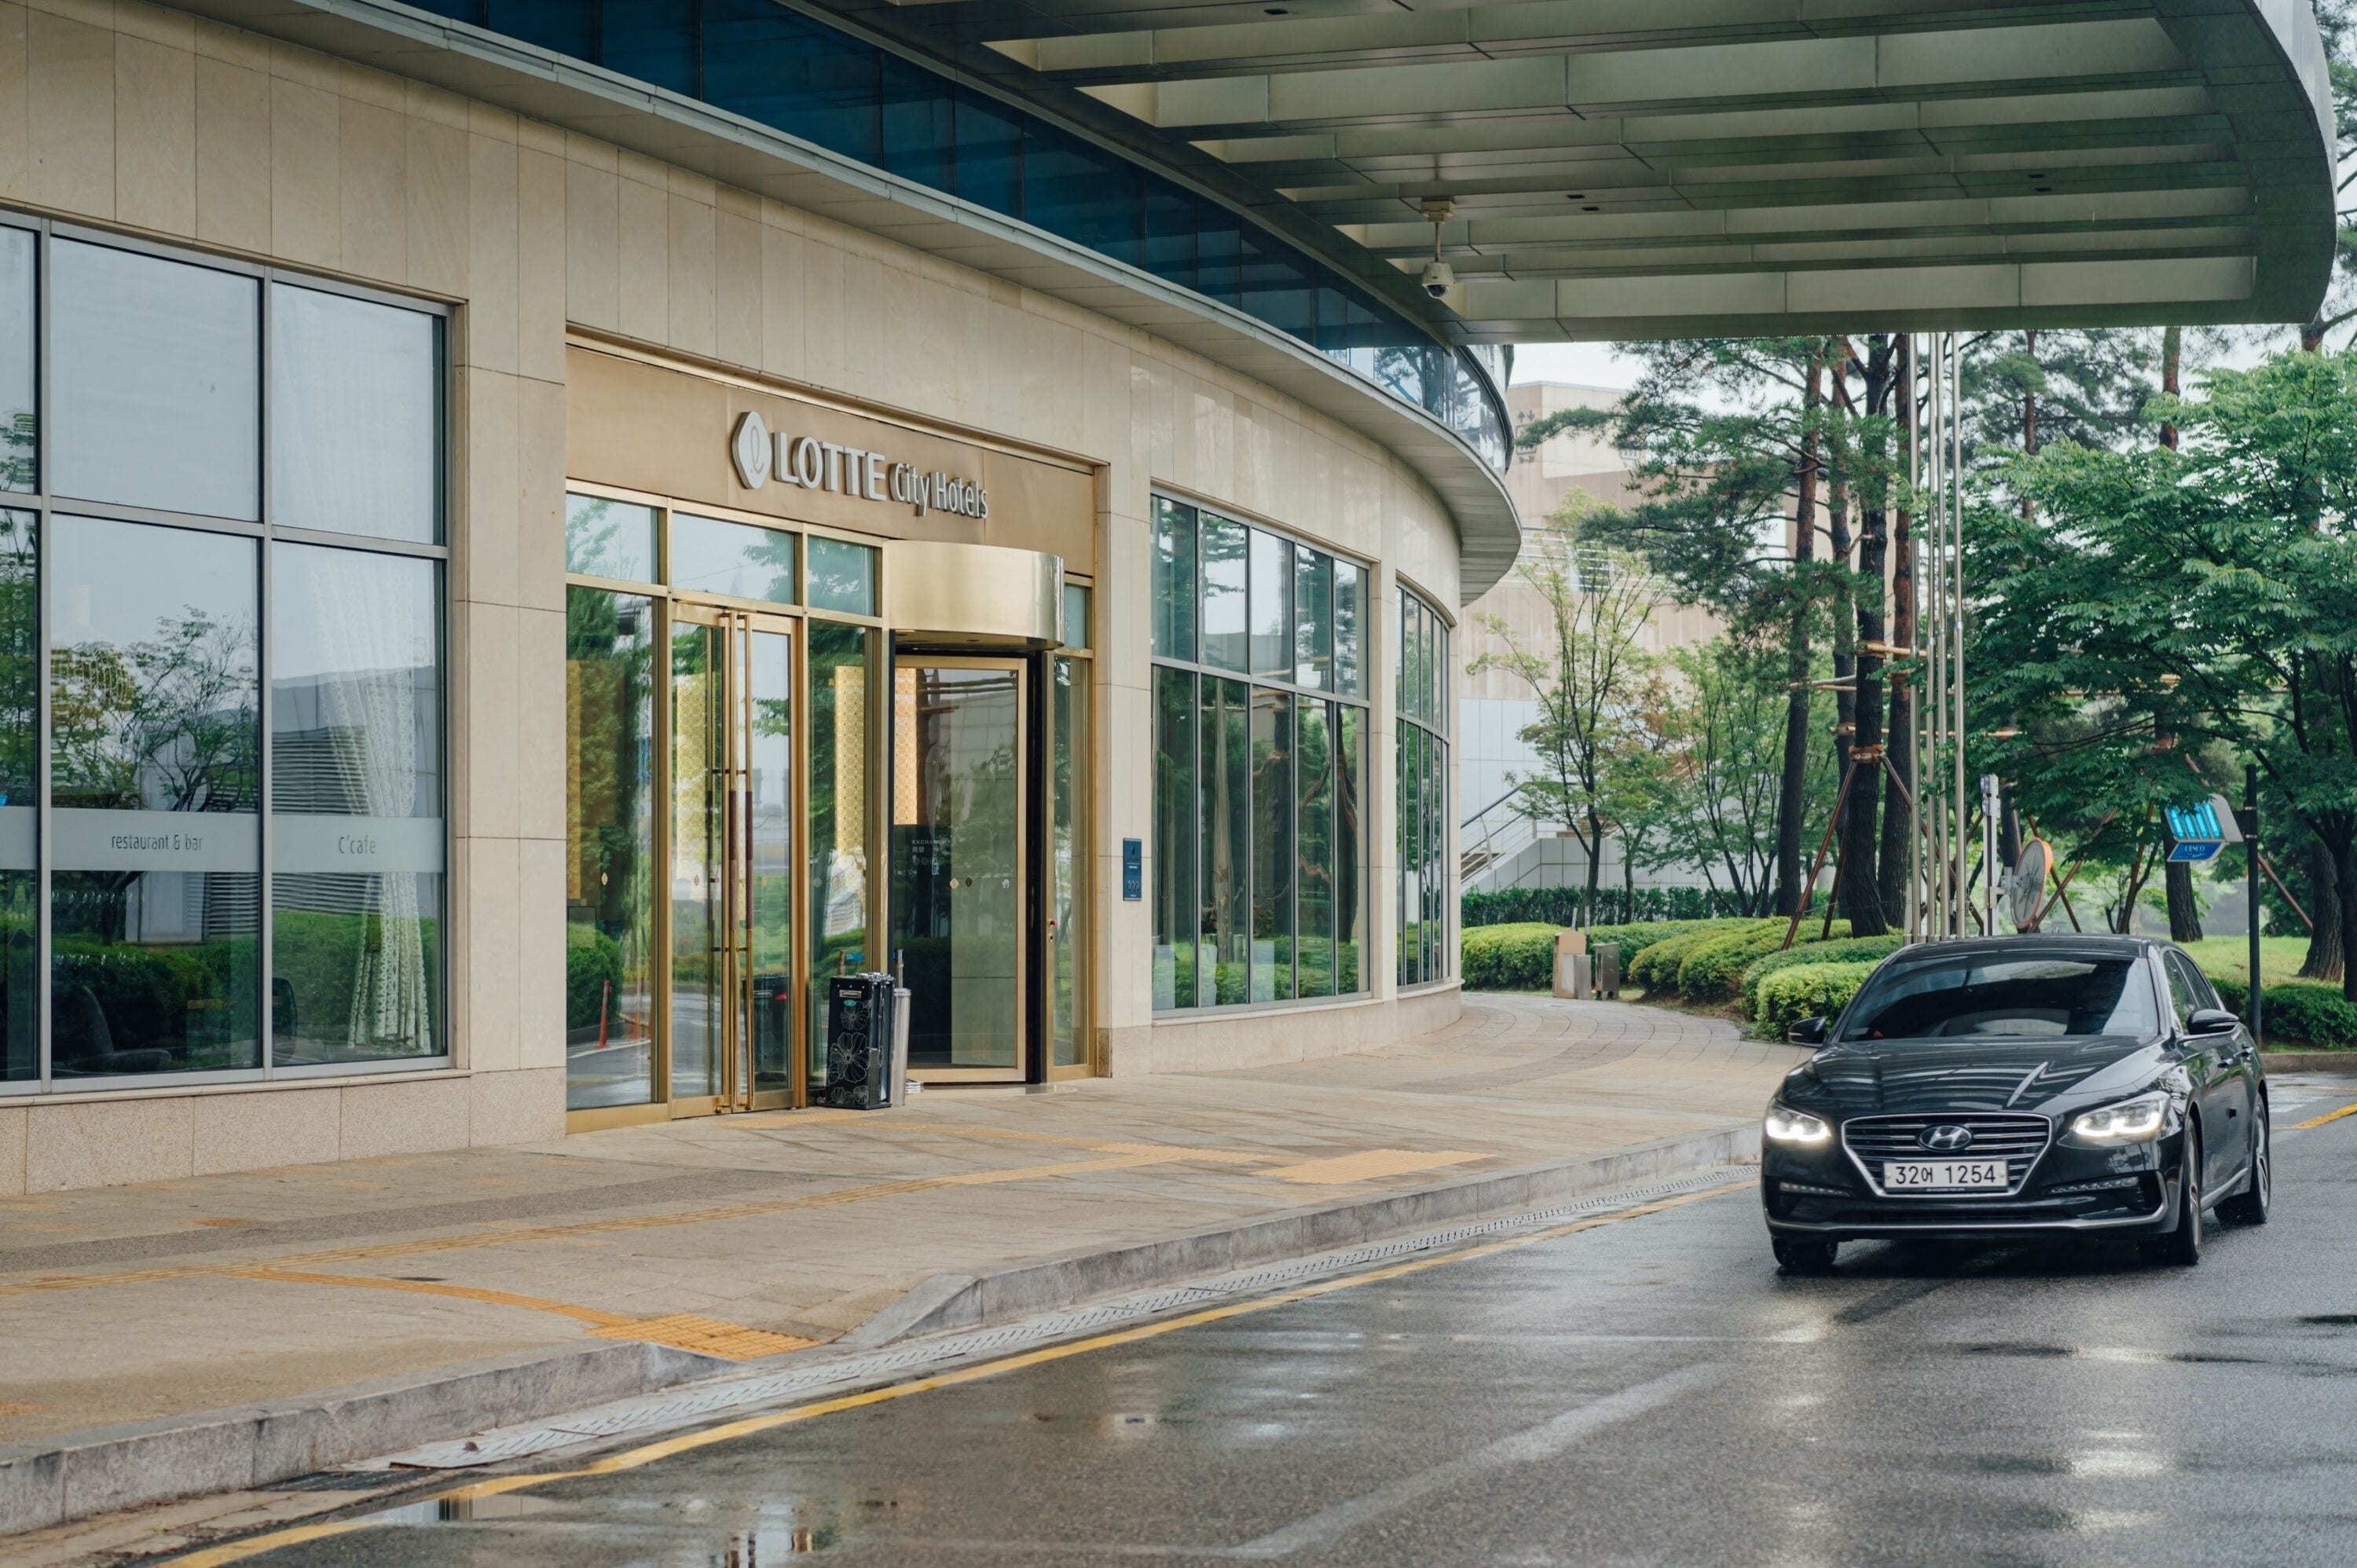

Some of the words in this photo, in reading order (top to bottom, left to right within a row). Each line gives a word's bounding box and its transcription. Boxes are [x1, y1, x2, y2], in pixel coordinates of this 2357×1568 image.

[775, 431, 886, 501] LOTTE
[889, 463, 930, 516] City
[931, 471, 988, 519] Hotels
[112, 834, 169, 849] restaurant
[174, 834, 181, 850] &
[185, 833, 203, 850] bar
[1895, 1166, 1934, 1185] 32어
[1945, 1164, 1996, 1184] 1254
